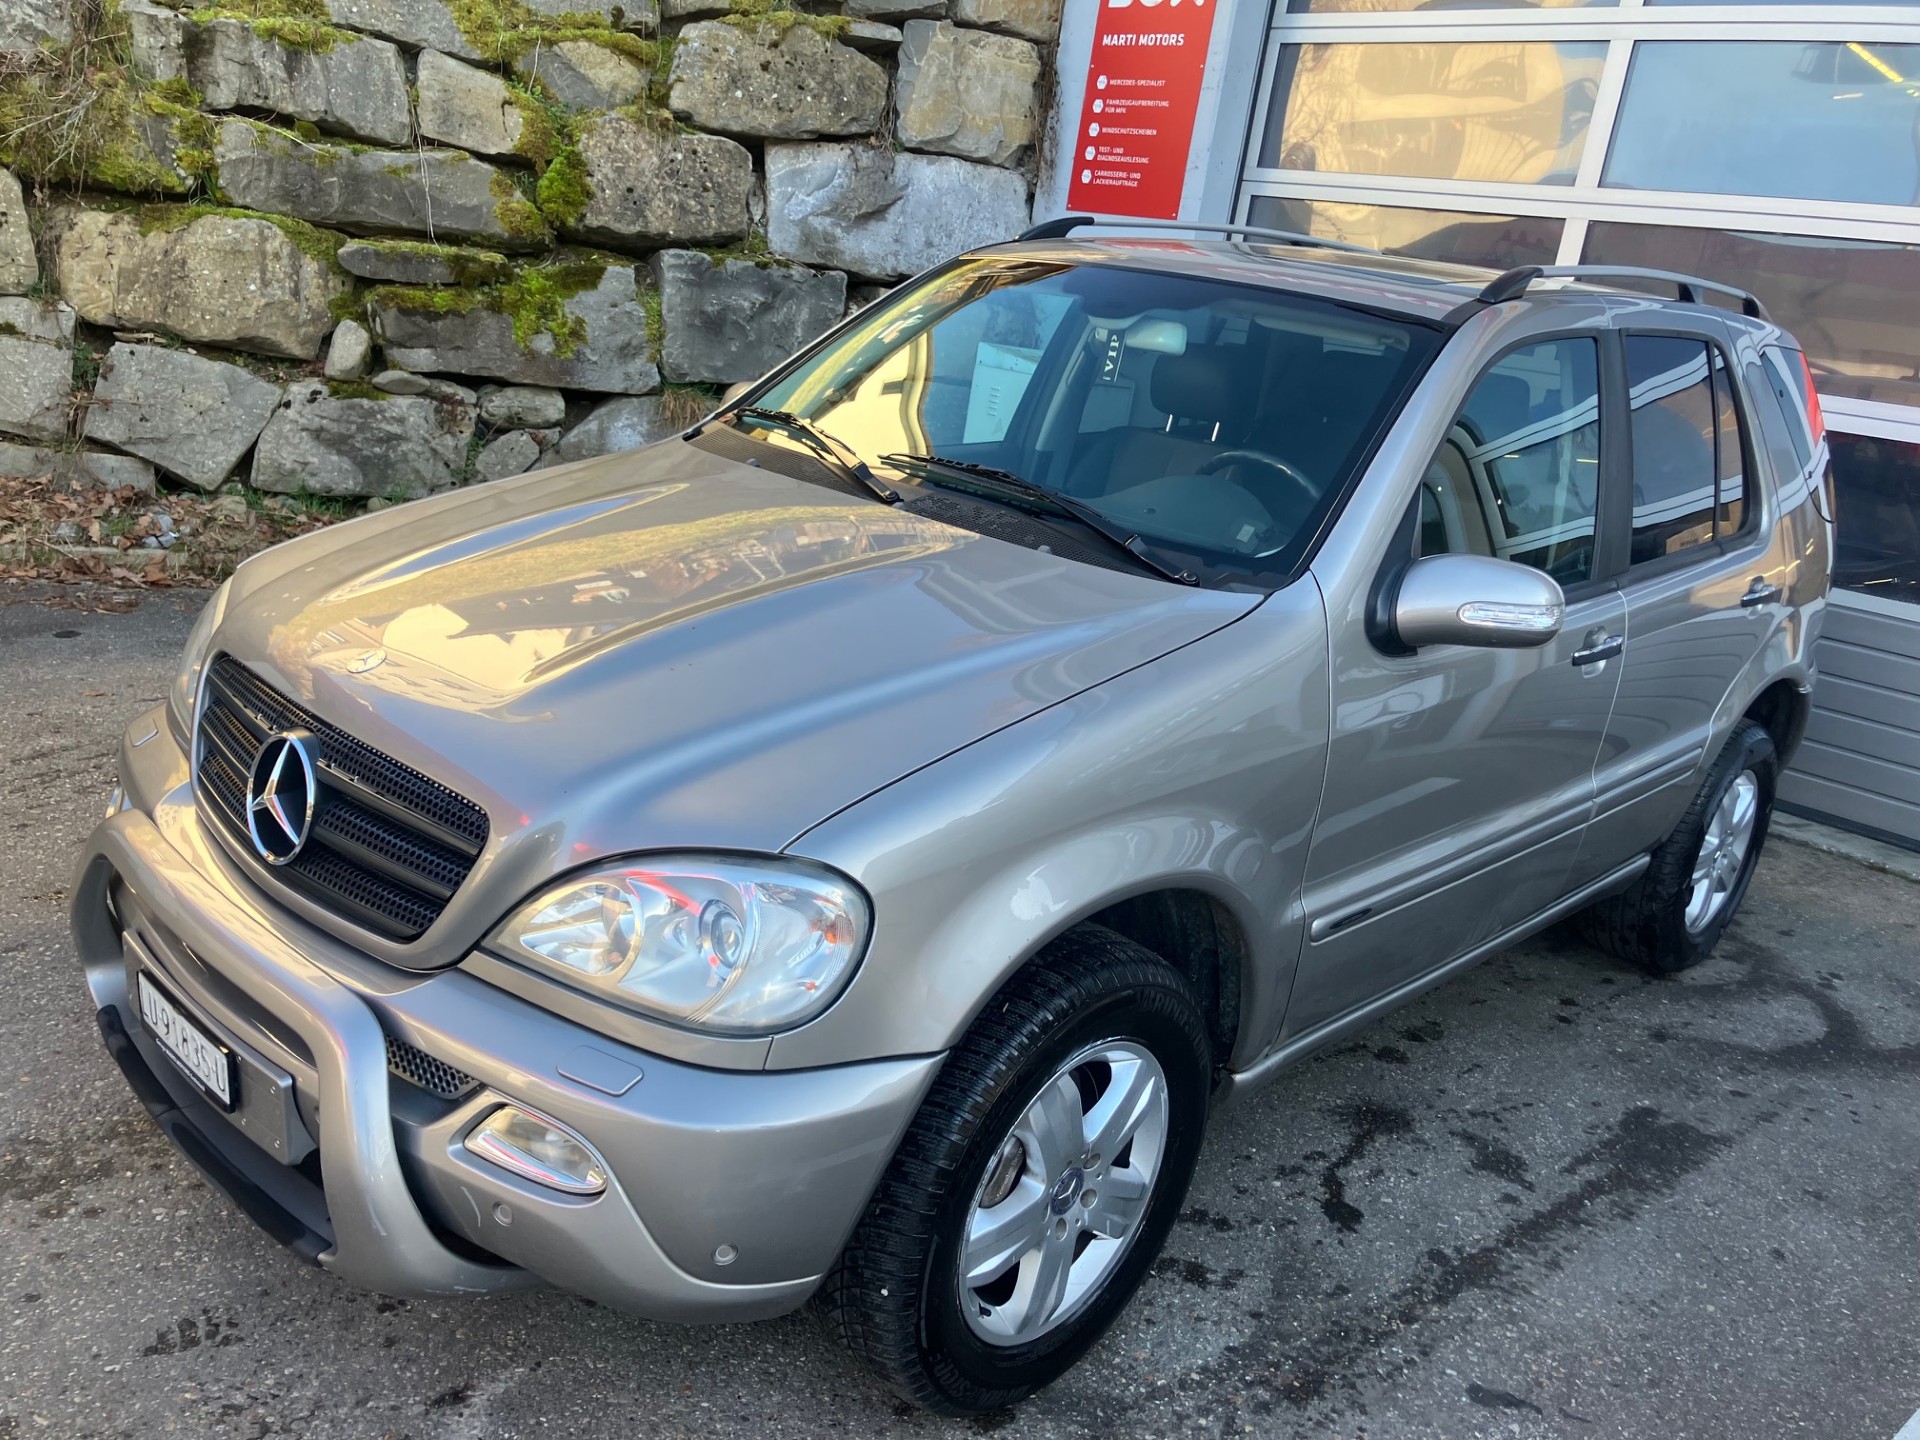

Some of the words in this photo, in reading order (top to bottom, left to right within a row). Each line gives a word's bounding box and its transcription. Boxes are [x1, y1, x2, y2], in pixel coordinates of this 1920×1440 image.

[1102, 35, 1136, 46] MARTI
[1139, 34, 1184, 46] MOTORS
[1106, 99, 1169, 107] FAHRZEUGAUFBEREITUNG
[1102, 127, 1157, 135] WINDSCHUTZSCHEIBEN
[1097, 155, 1149, 163] DIAGNOSEAUSLESUNG
[1104, 334, 1119, 373] VIP
